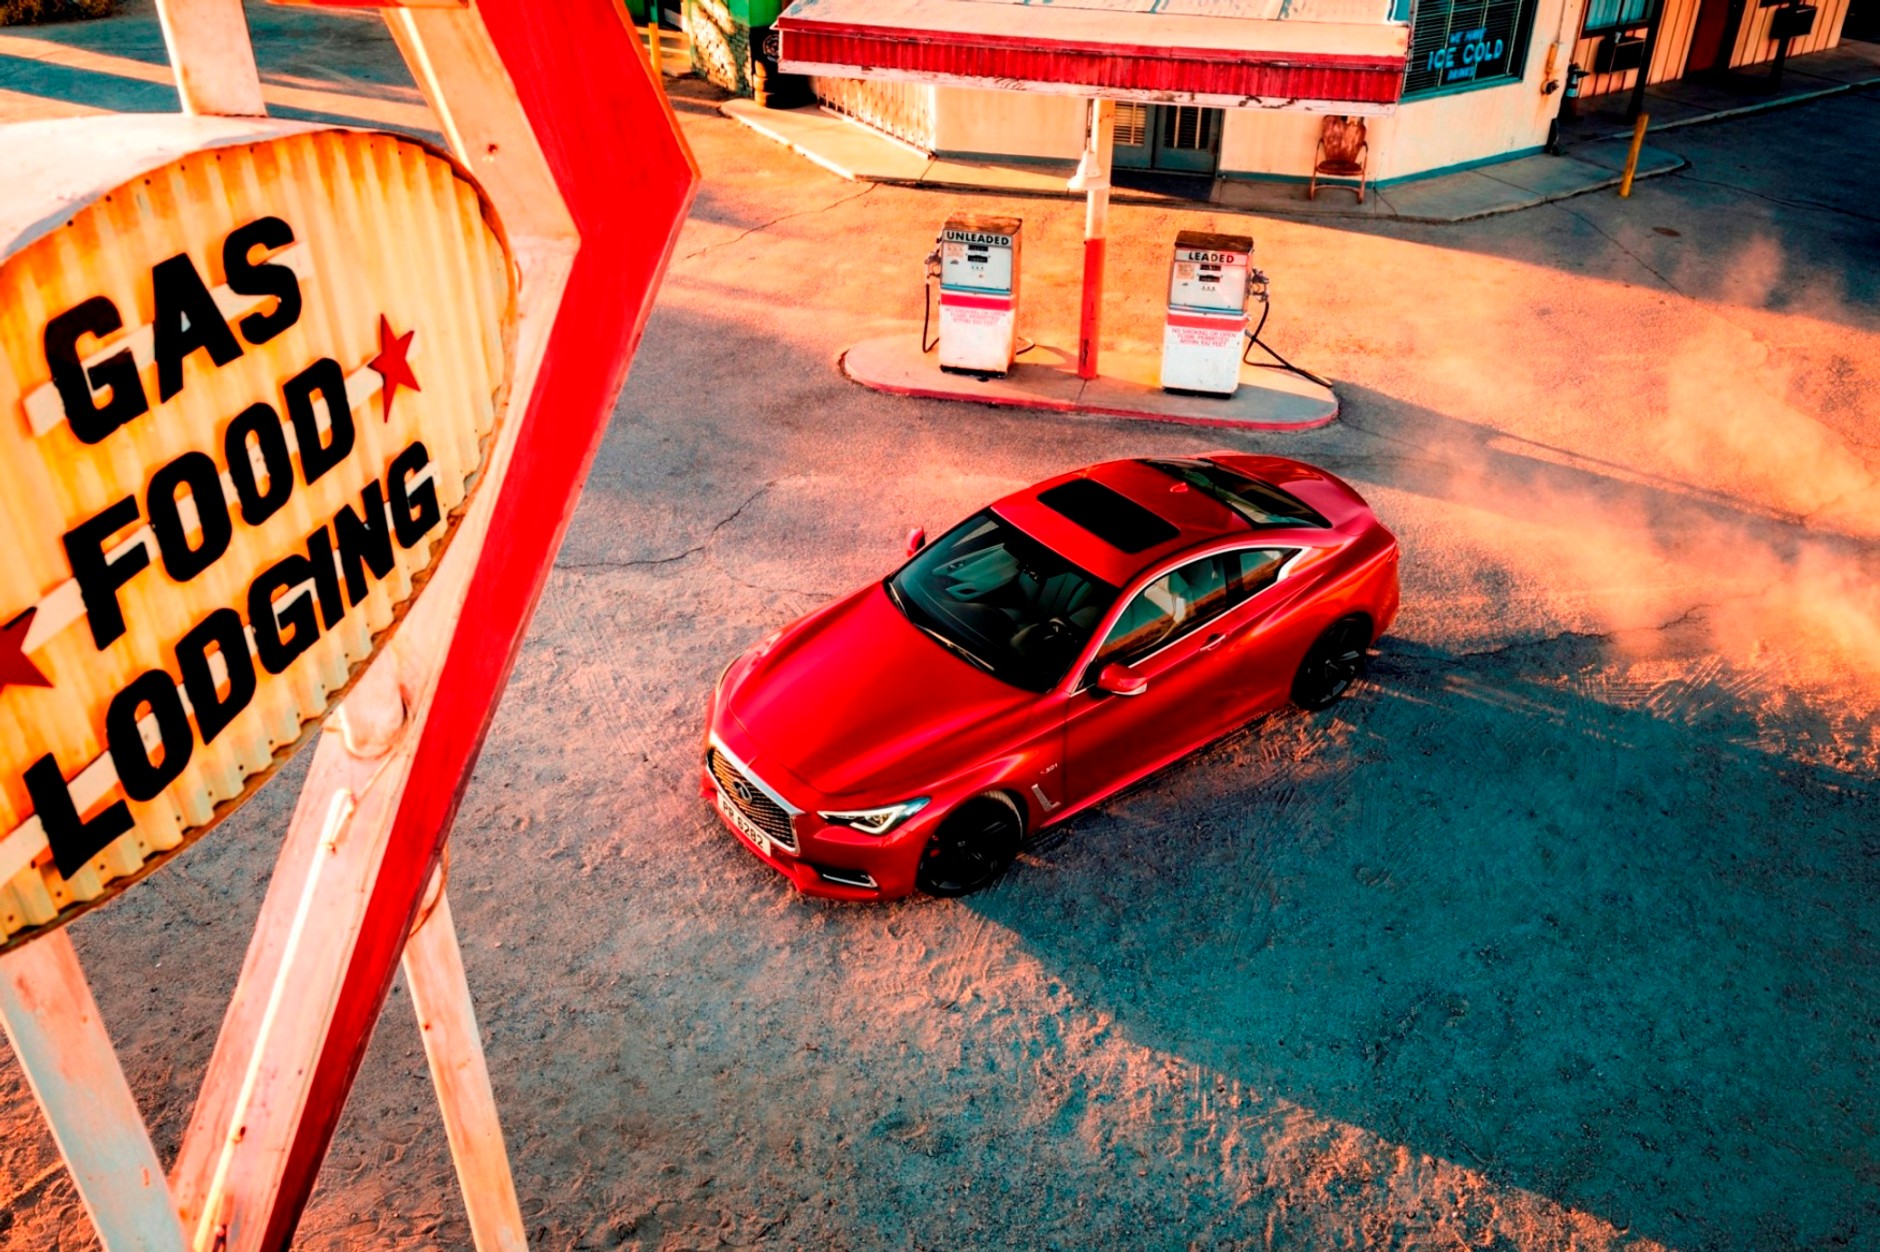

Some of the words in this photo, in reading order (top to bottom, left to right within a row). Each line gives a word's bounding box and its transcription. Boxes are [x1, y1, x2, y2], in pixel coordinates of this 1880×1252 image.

[1427, 47, 1457, 72] ICE
[1463, 39, 1503, 64] COLD
[946, 231, 1009, 245] UNLEADED
[1188, 251, 1234, 263] LEADED
[44, 216, 302, 444] GAS
[63, 357, 356, 652] FOOD
[23, 441, 440, 881] LODGING
[723, 800, 734, 822] PR
[737, 816, 764, 849] 6282
